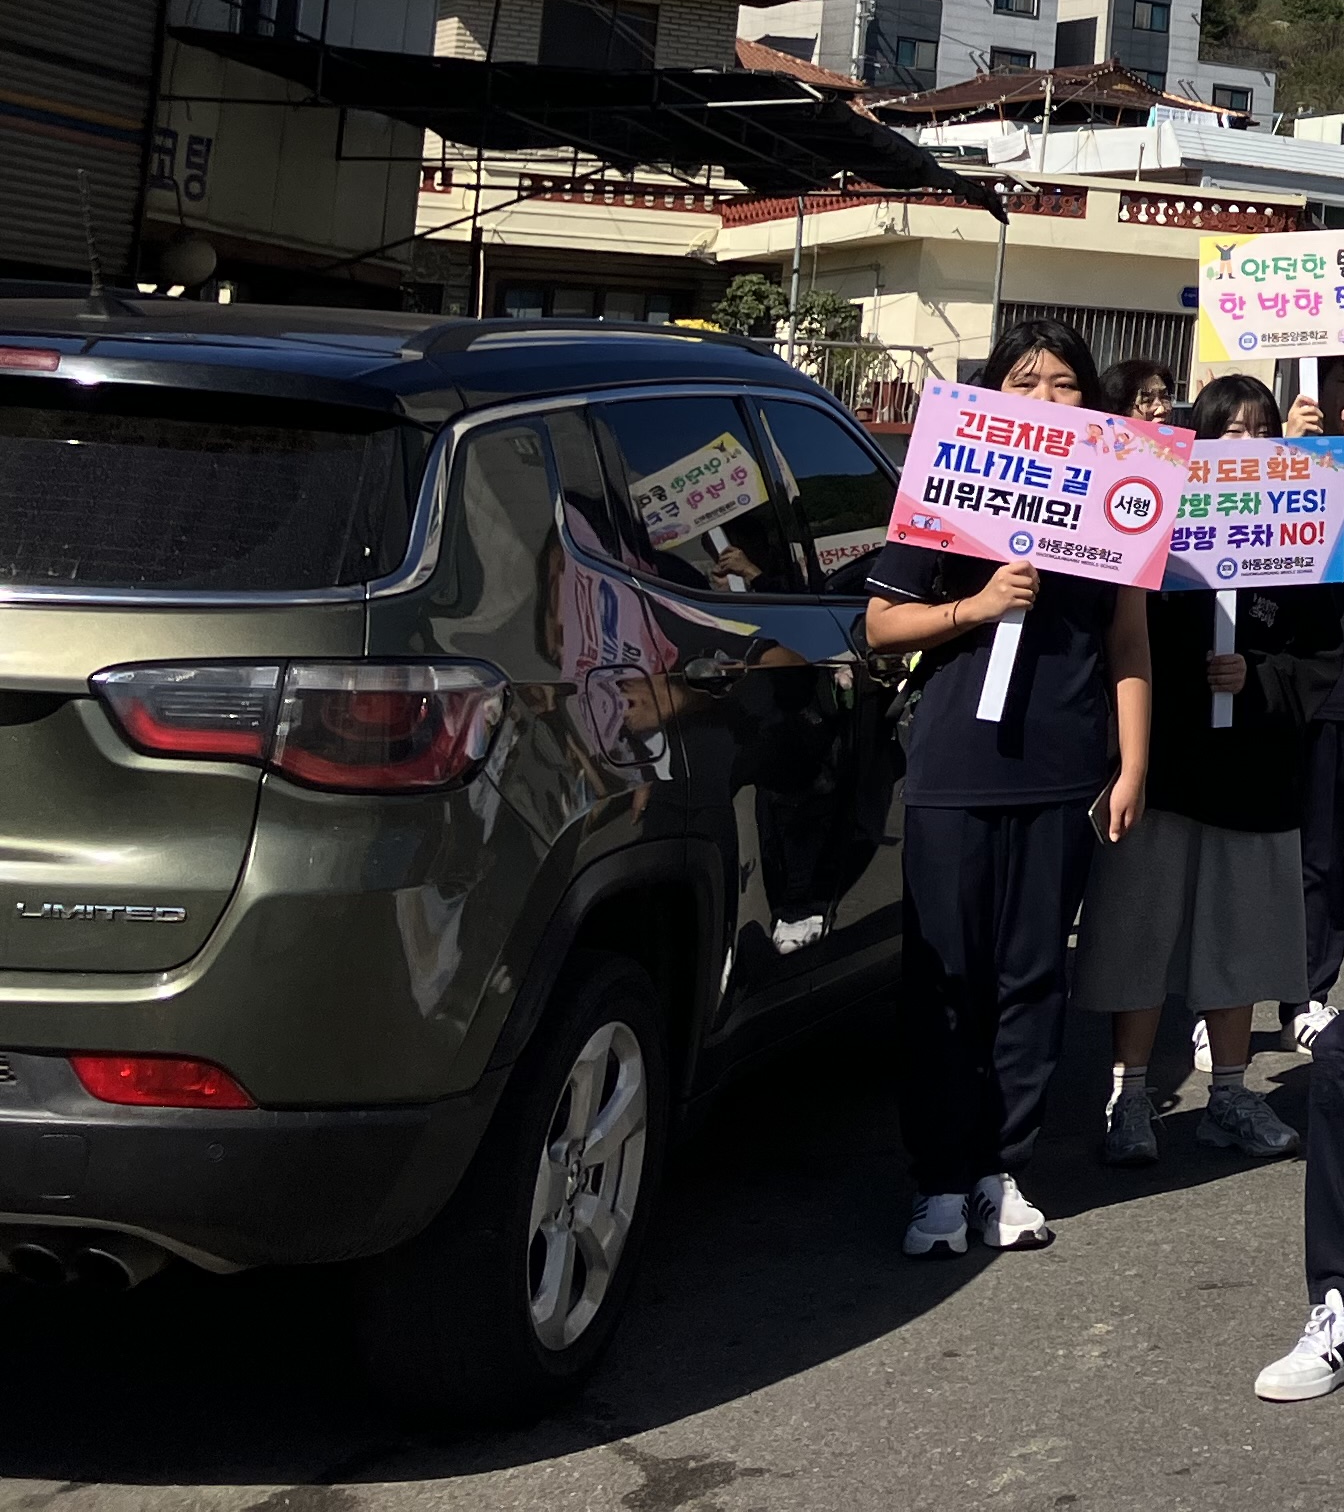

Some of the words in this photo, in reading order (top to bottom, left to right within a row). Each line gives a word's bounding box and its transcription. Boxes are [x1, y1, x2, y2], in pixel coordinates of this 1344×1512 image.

[1241, 253, 1327, 282] 안전한
[1218, 292, 1247, 321] 한
[1257, 288, 1323, 318] 방향
[1260, 330, 1329, 344] 하동중앙중학교
[955, 410, 1076, 457] 긴급차량
[934, 441, 1053, 489] 지나가는
[1061, 464, 1092, 496] 길
[1187, 459, 1211, 484] 차
[1216, 458, 1261, 482] 도로
[1266, 456, 1311, 482] 확보
[922, 476, 1083, 530] 비워주세요!
[1114, 495, 1151, 518] 서행
[1216, 491, 1262, 517] 주차
[1266, 488, 1327, 514] YES!
[1226, 523, 1274, 549] 주차
[1279, 521, 1325, 546] NO!
[1037, 536, 1122, 564] 하동중앙중학교
[1241, 556, 1315, 571] 하동중앙중학교
[15, 900, 187, 925] LIMITED
